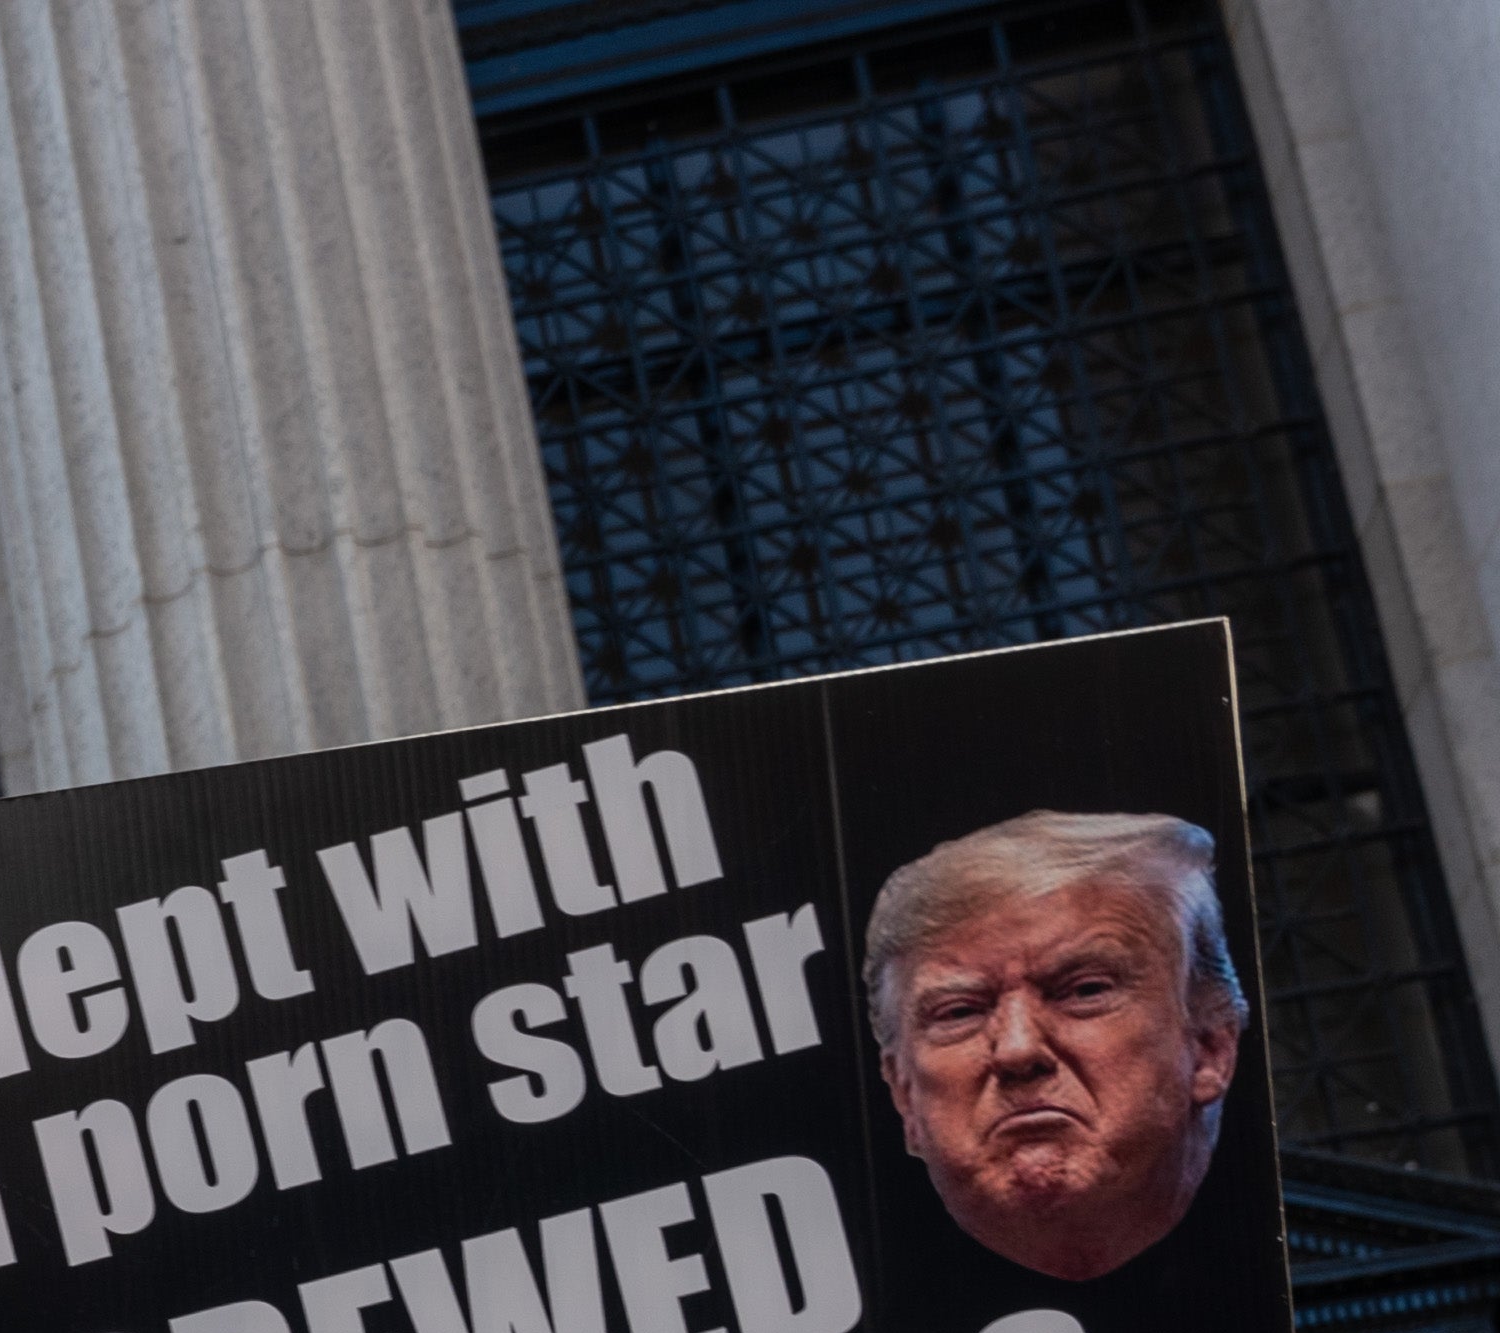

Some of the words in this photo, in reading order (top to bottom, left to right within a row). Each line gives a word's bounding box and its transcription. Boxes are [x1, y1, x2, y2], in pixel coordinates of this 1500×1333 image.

[315, 732, 724, 976] with
[34, 1016, 452, 1268] porn
[471, 901, 825, 1125] star
